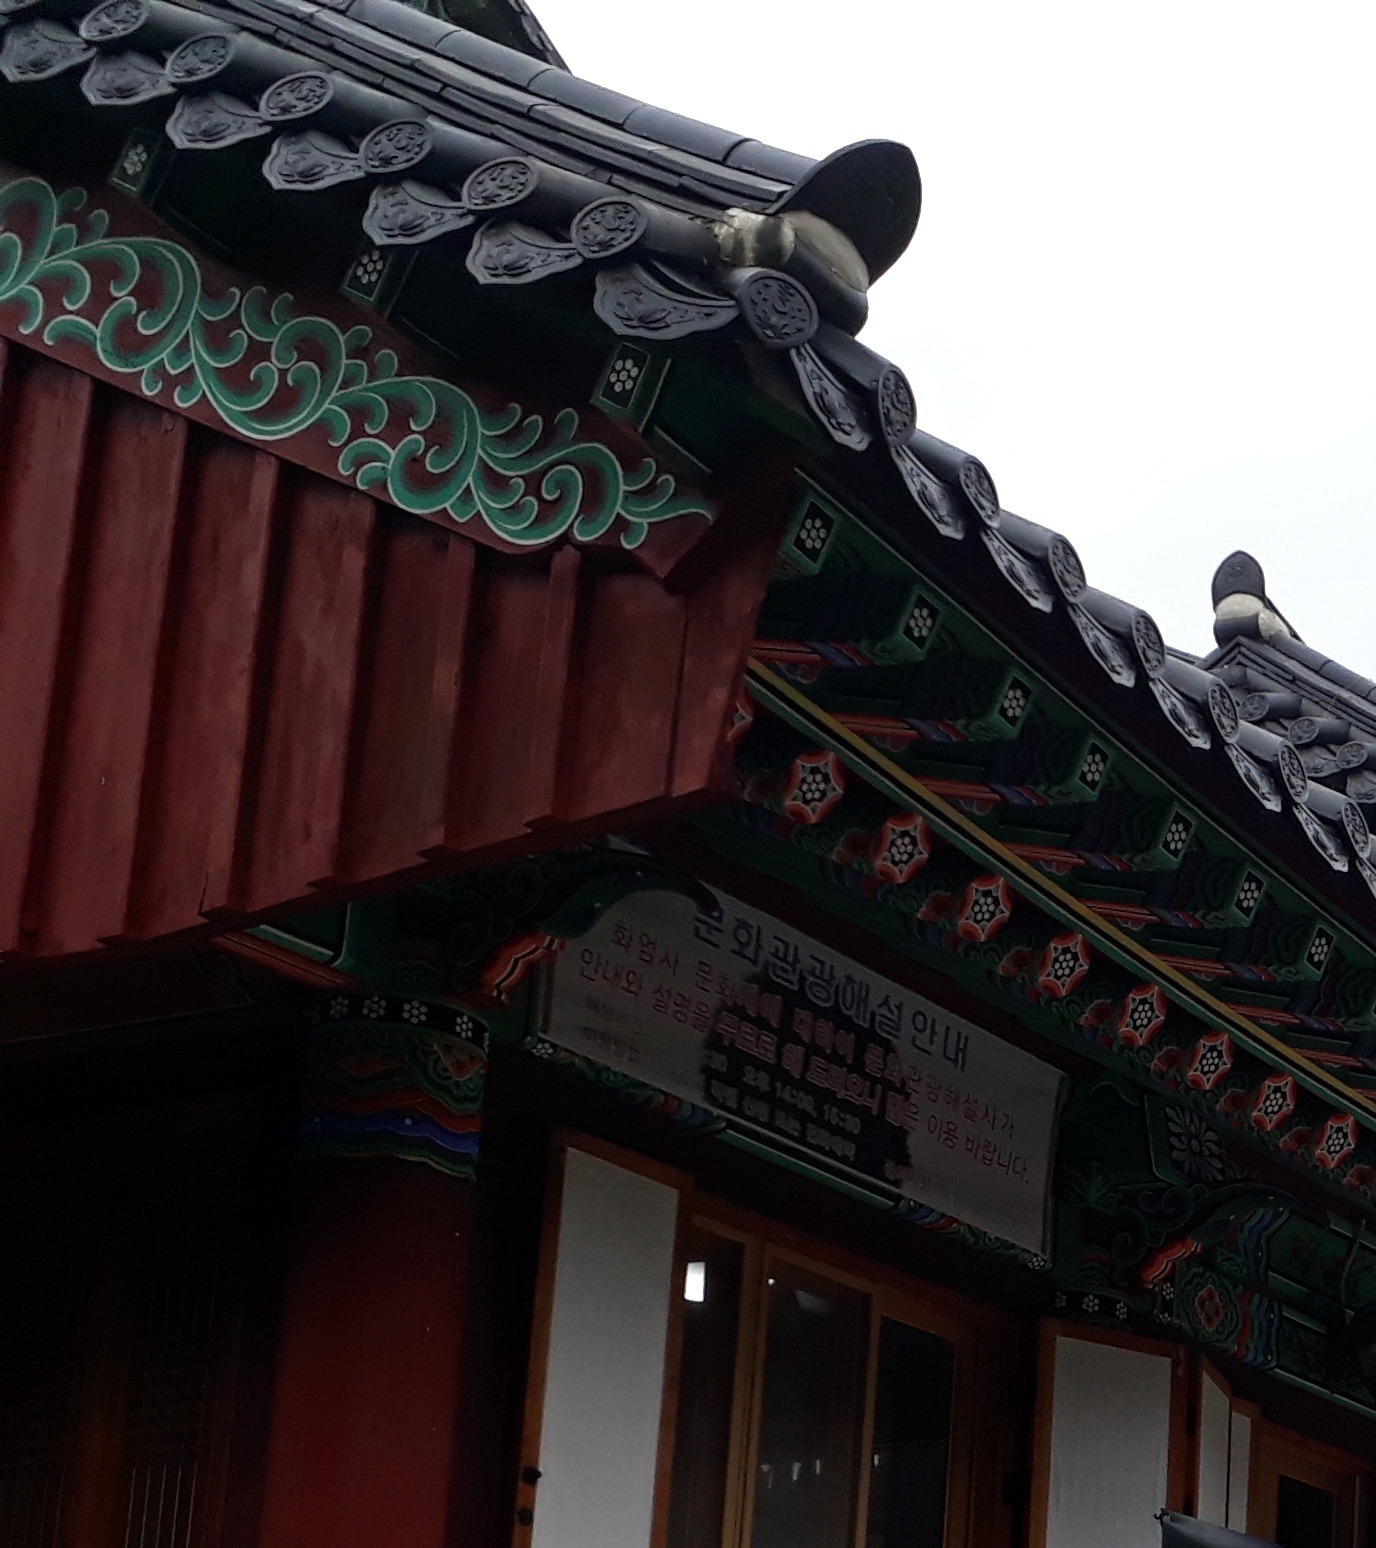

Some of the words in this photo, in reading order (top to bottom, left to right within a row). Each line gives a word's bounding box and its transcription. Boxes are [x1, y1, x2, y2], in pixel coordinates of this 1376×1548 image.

[580, 947, 643, 998] 안내와
[926, 1112, 959, 1150] 이용
[963, 1129, 1031, 1185] 바랍니다.
